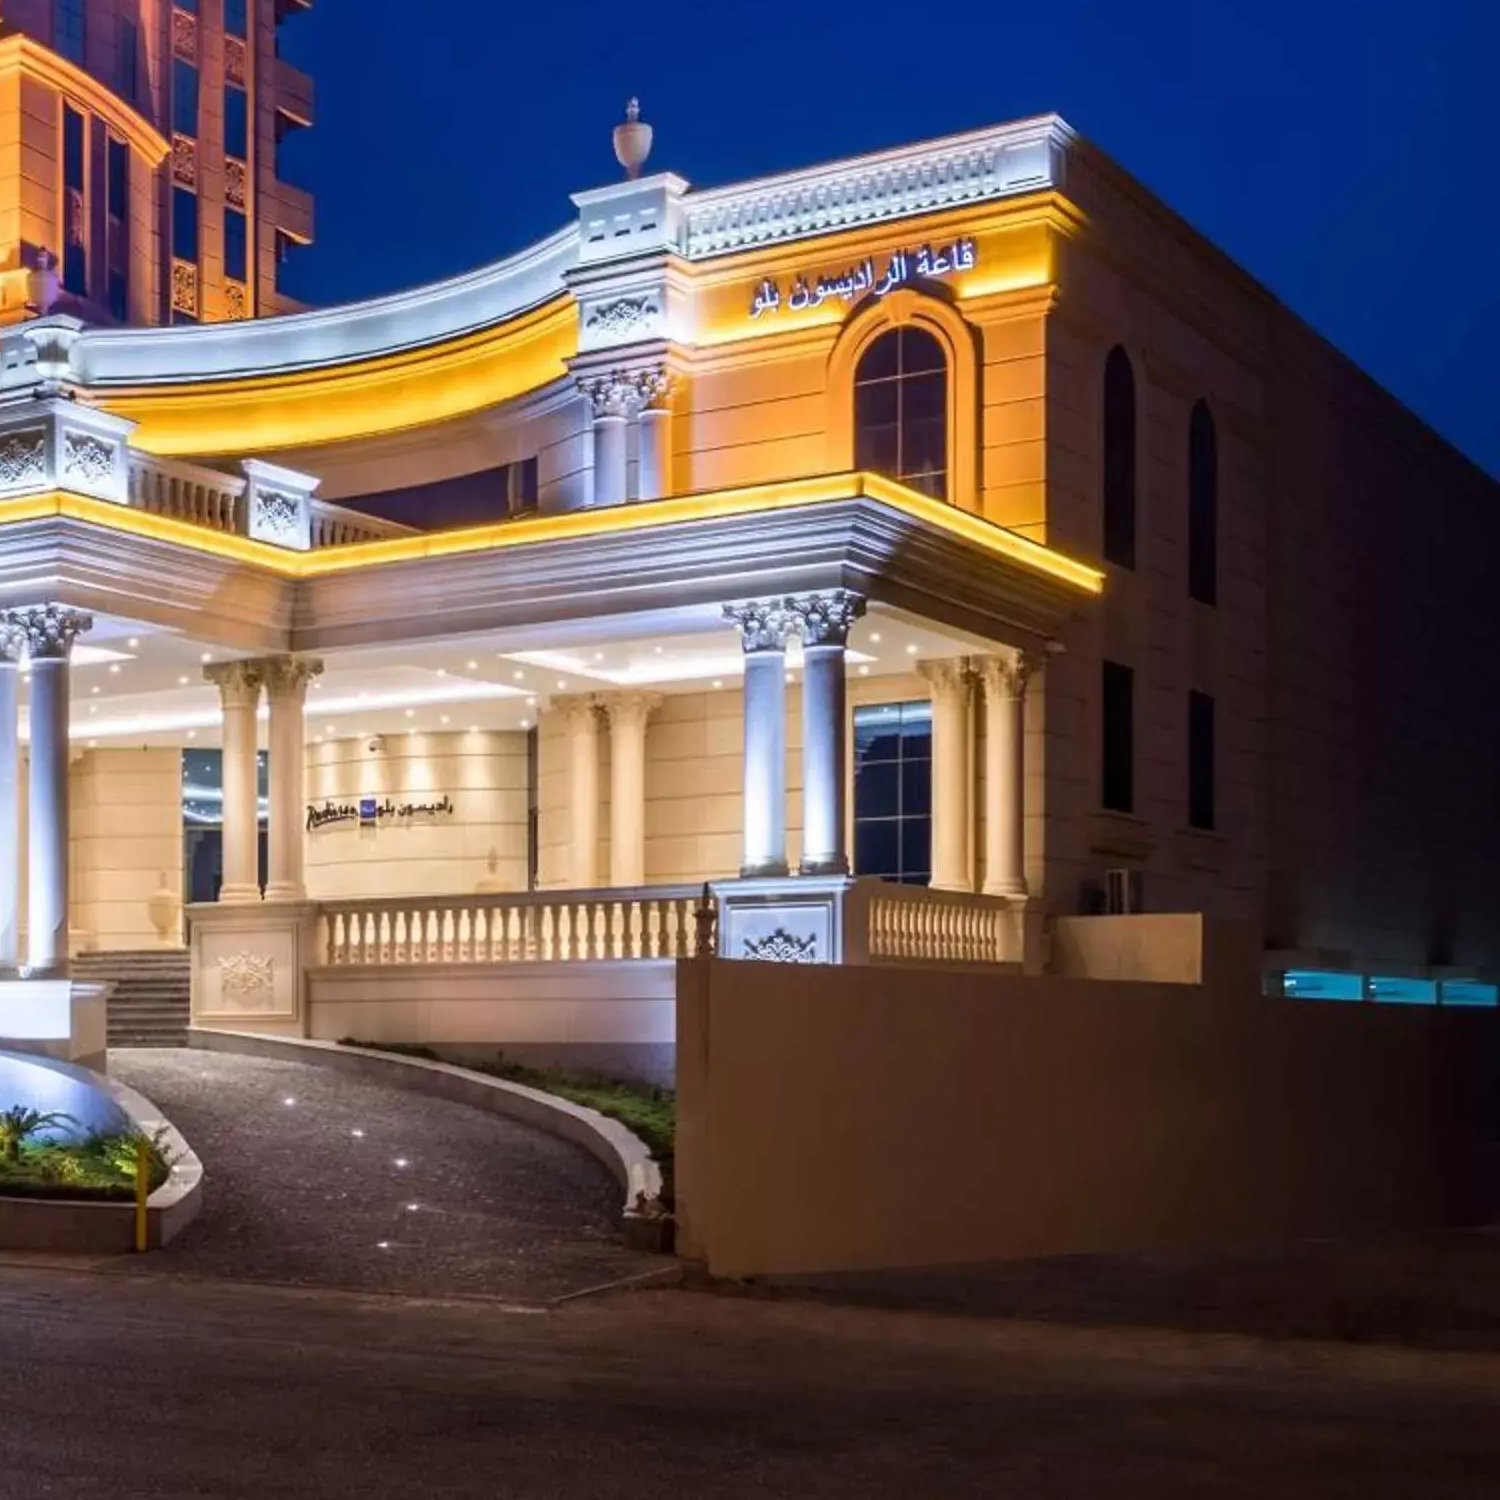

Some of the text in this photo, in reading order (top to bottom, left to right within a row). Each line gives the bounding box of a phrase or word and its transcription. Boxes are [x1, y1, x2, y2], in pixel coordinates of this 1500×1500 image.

[749, 242, 974, 319] قاعة الراديسون بلو
